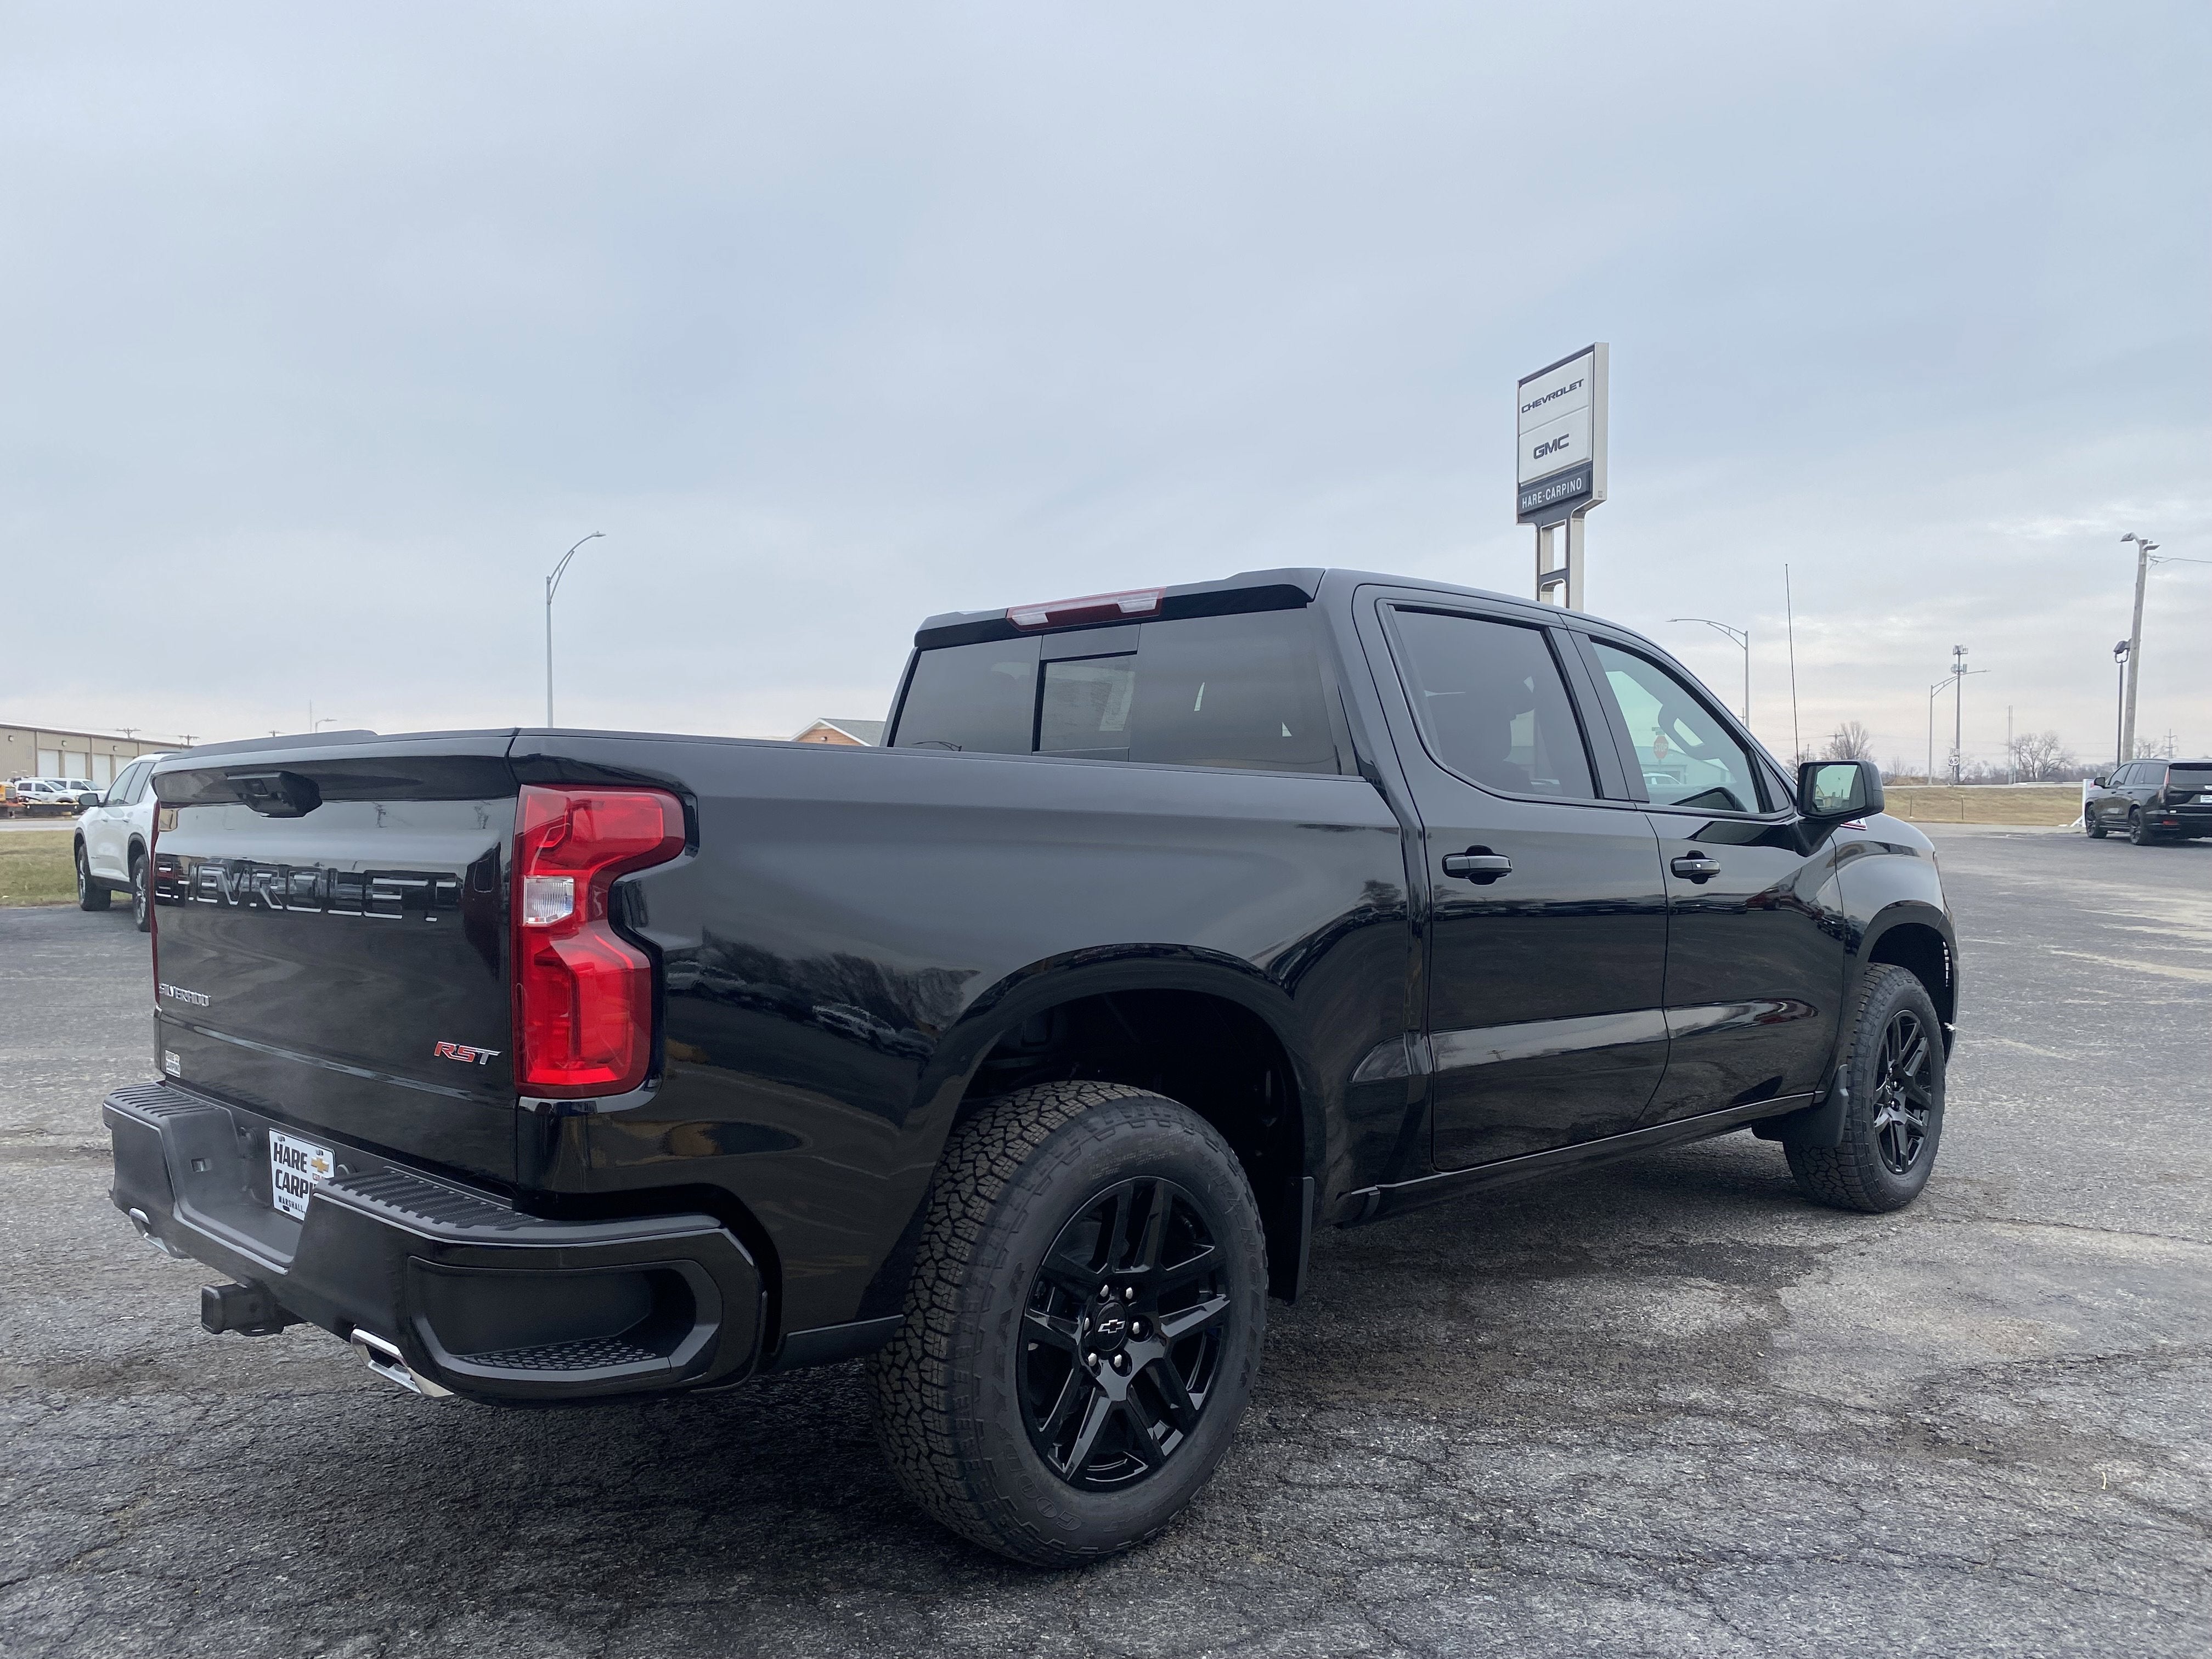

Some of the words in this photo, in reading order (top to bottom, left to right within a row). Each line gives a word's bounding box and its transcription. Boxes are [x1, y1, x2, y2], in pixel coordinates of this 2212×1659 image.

[1521, 379, 1584, 414] CHEVROLET
[1533, 433, 1569, 460] GMC
[1522, 477, 1582, 509] HARE-CARPINO
[1655, 743, 1668, 752] STOP
[434, 1041, 503, 1065] RST
[274, 1142, 308, 1173] HARE
[275, 1169, 317, 1199] CARPI
